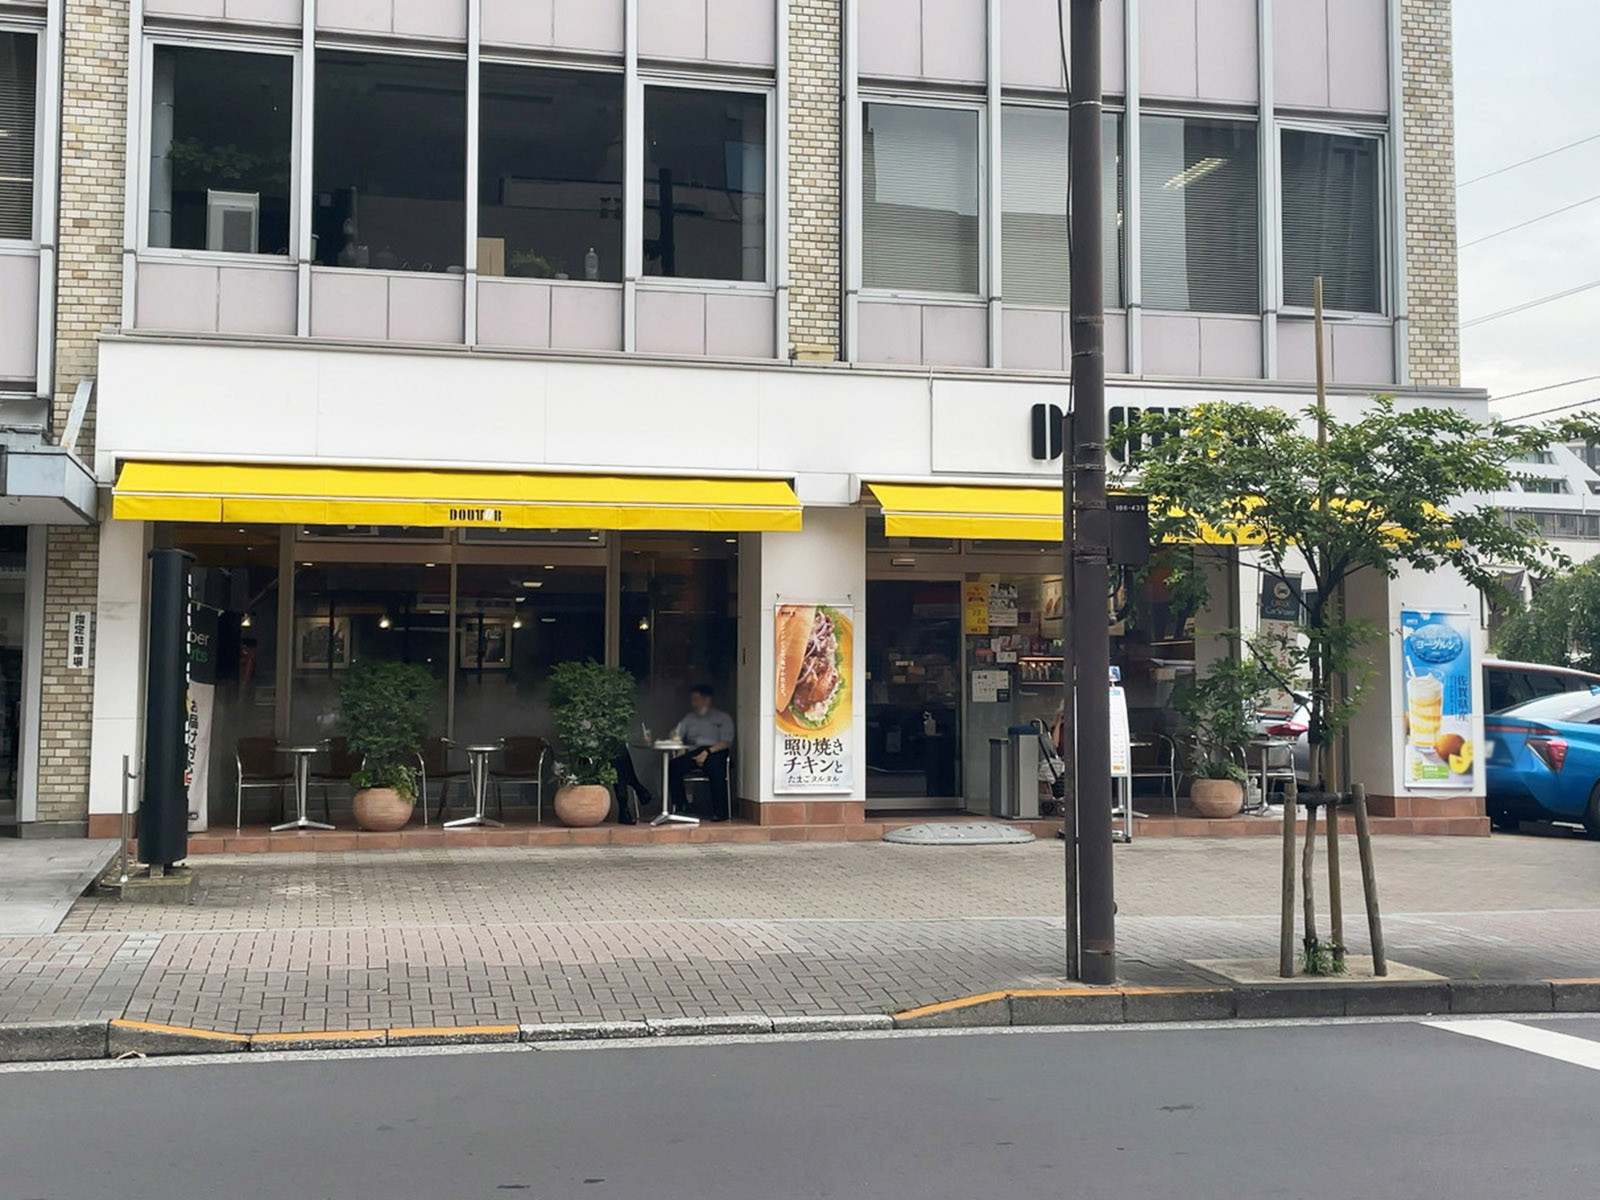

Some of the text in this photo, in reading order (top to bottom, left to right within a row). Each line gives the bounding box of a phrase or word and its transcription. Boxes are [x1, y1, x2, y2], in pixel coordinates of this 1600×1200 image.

[450, 508, 501, 521] DOUTOR
[73, 614, 85, 668] 指定駐車場
[190, 628, 210, 646] ber
[784, 737, 843, 756] 照り焼き
[783, 756, 843, 774] チキンと
[788, 775, 840, 784] たまごタルタル
